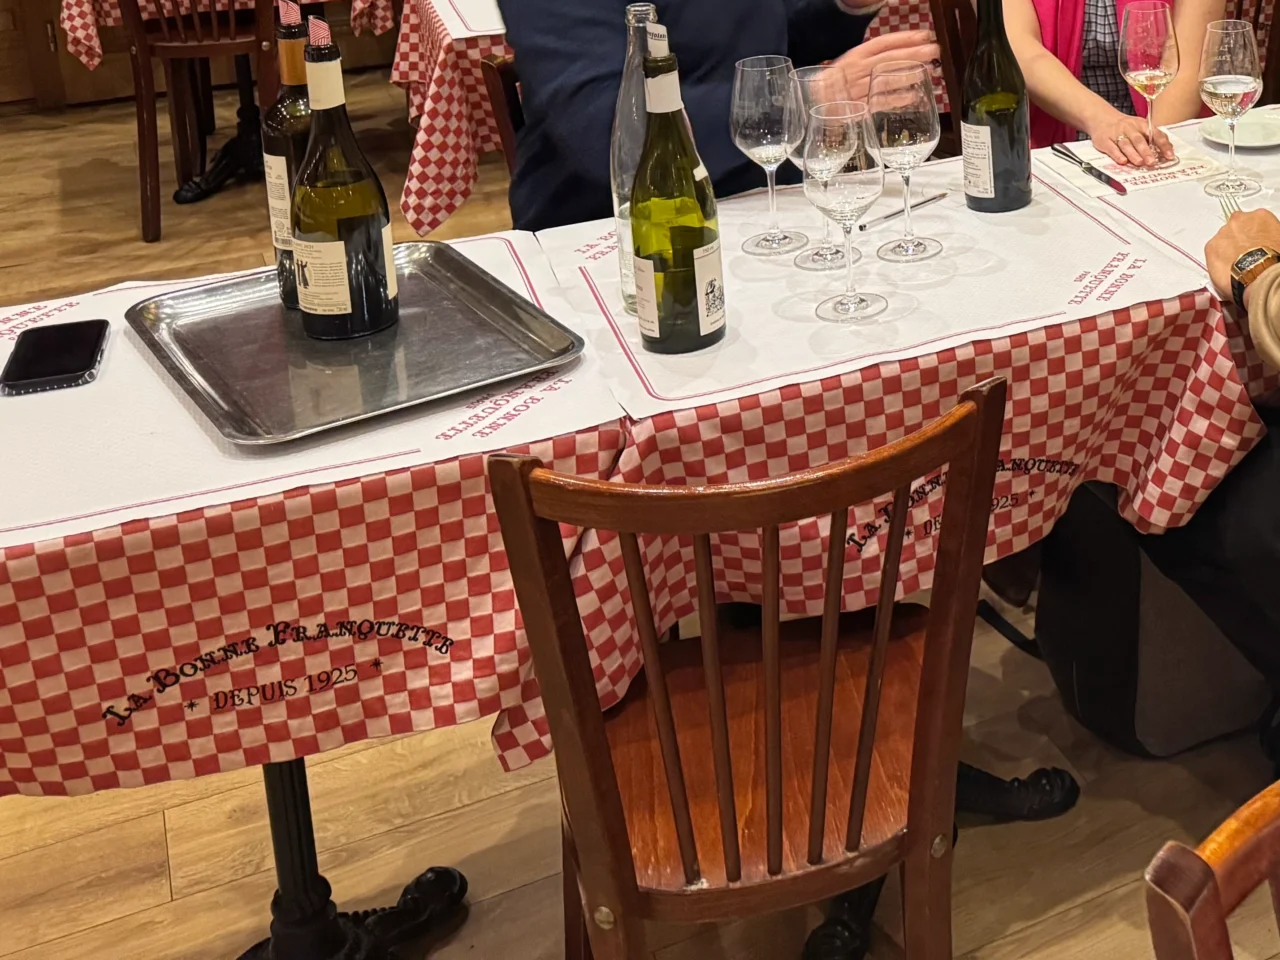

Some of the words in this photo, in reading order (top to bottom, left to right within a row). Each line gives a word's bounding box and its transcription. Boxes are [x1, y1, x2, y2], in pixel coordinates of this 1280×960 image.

[1067, 251, 1131, 306] FRANQUETTE
[1127, 258, 1147, 271] LA
[1096, 272, 1135, 302] BONNE
[540, 376, 572, 392] LA
[435, 369, 560, 441] FRANQUETTE
[472, 395, 544, 438] BONNE
[990, 493, 1019, 512] 925
[847, 521, 882, 553] LA
[101, 692, 152, 727] LA
[146, 636, 261, 695] BONNE
[265, 619, 455, 655] FRANQUETTE
[213, 678, 298, 710] DEPUIS
[304, 663, 358, 694] 1925
